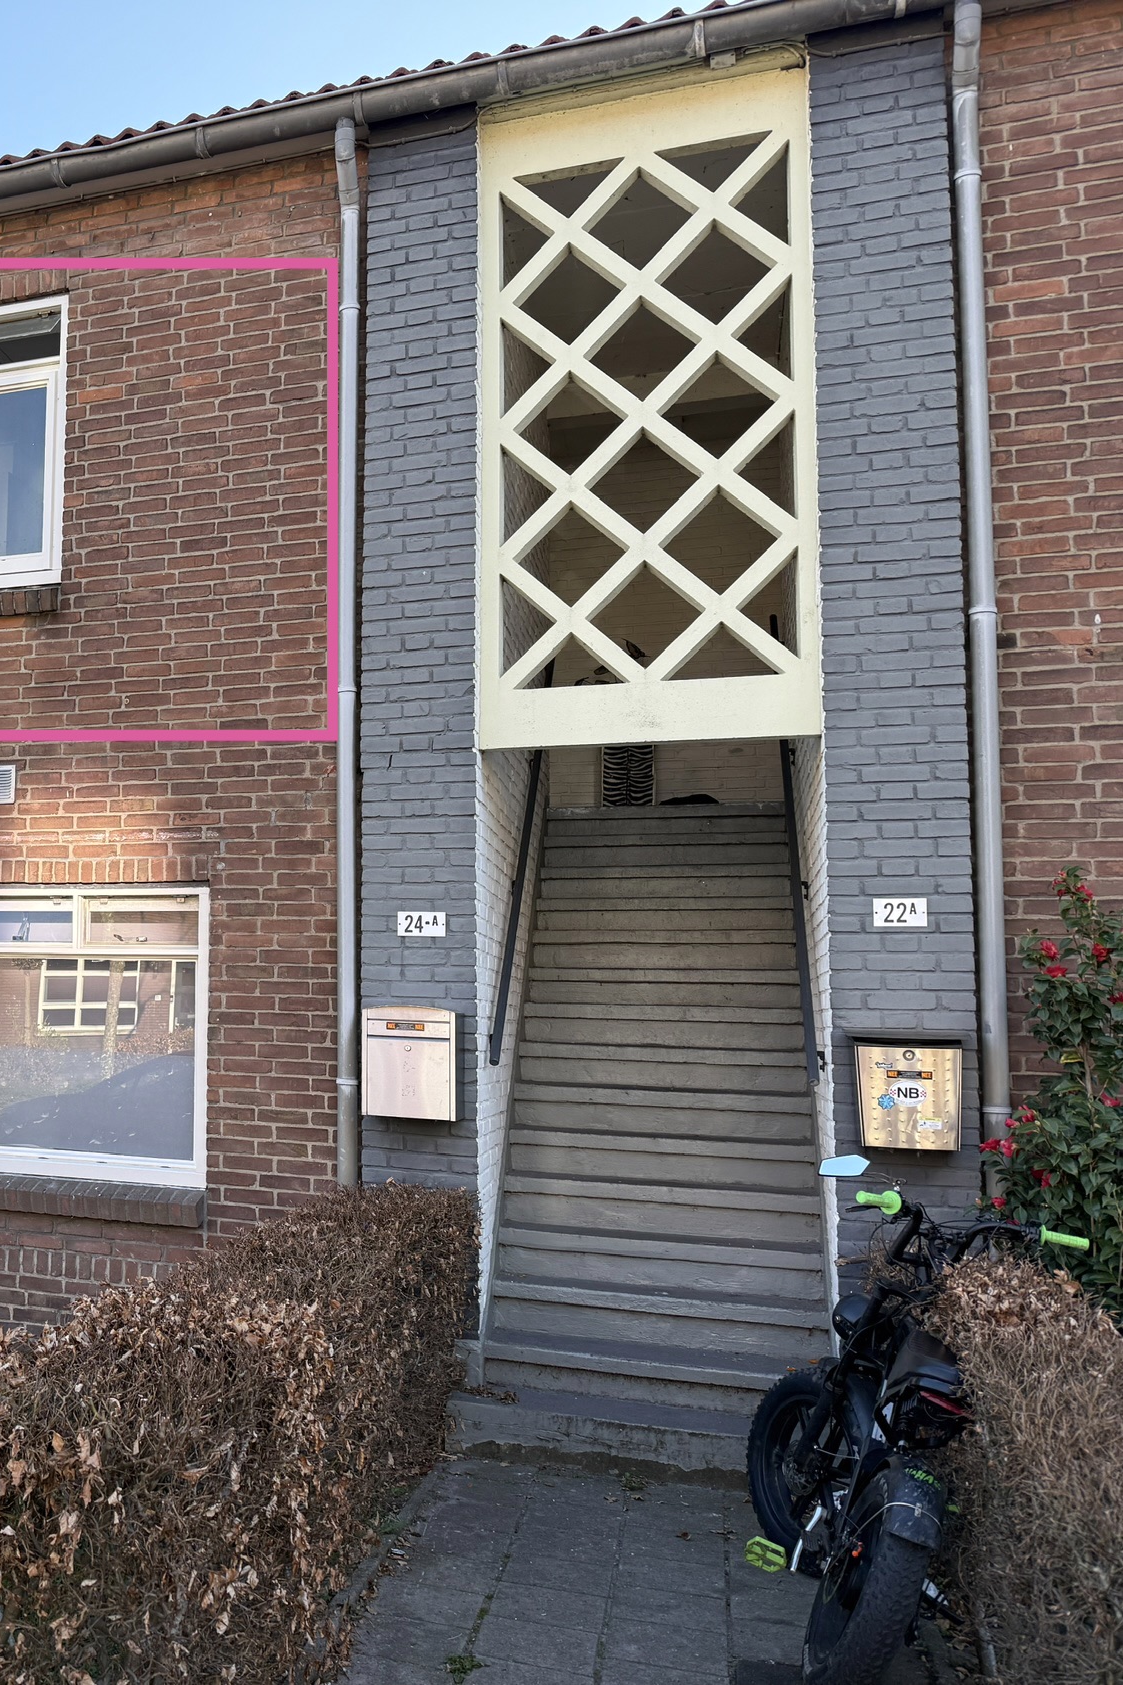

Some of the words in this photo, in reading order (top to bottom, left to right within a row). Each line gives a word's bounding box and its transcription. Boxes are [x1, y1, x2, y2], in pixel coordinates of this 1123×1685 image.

[883, 902, 917, 923] 22A
[404, 914, 438, 933] 24-A
[897, 1086, 920, 1099] NB
